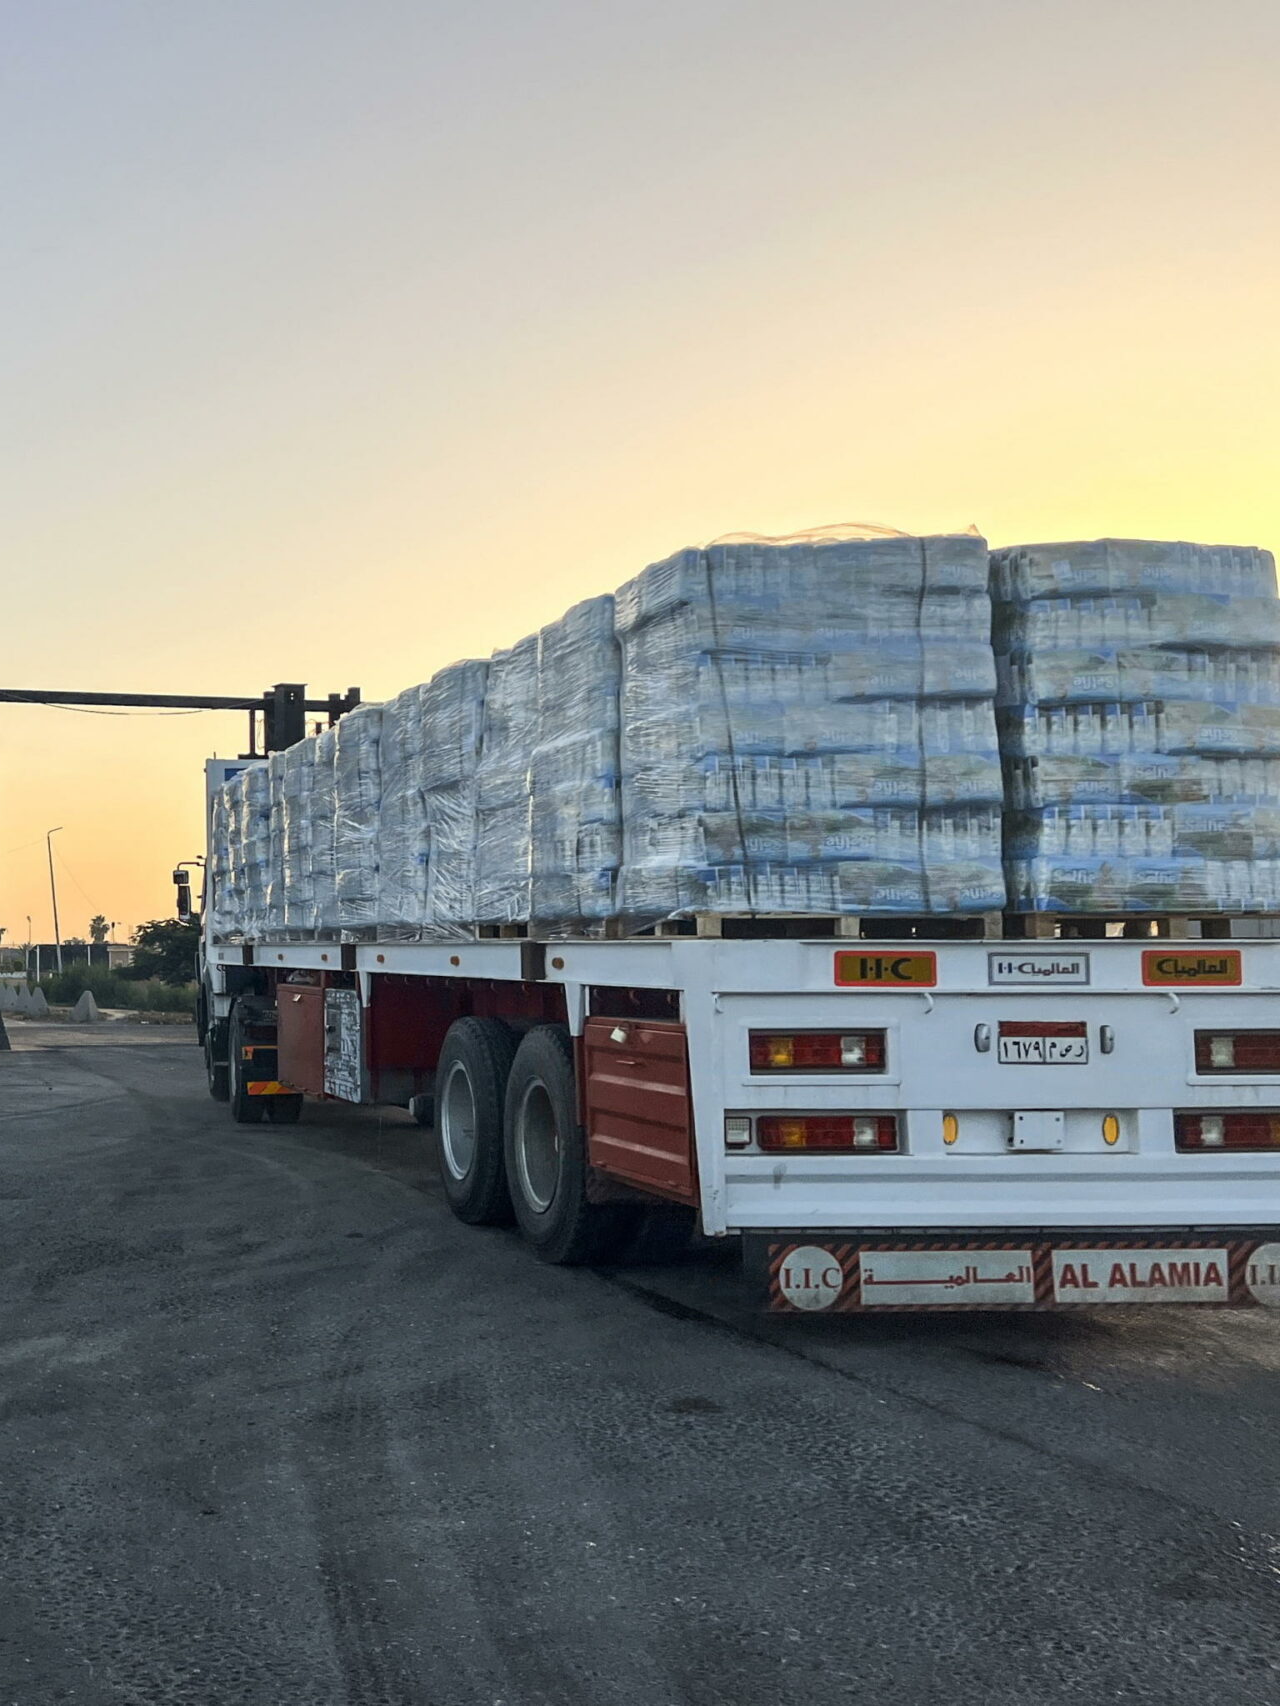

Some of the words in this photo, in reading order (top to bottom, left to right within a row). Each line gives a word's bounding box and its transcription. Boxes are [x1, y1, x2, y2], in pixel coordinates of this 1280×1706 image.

[1073, 675, 1115, 691] Selfie
[863, 1265, 1032, 1289] العالمية
[1059, 1263, 1099, 1289] AL
[1108, 1262, 1223, 1288] ALAMIA
